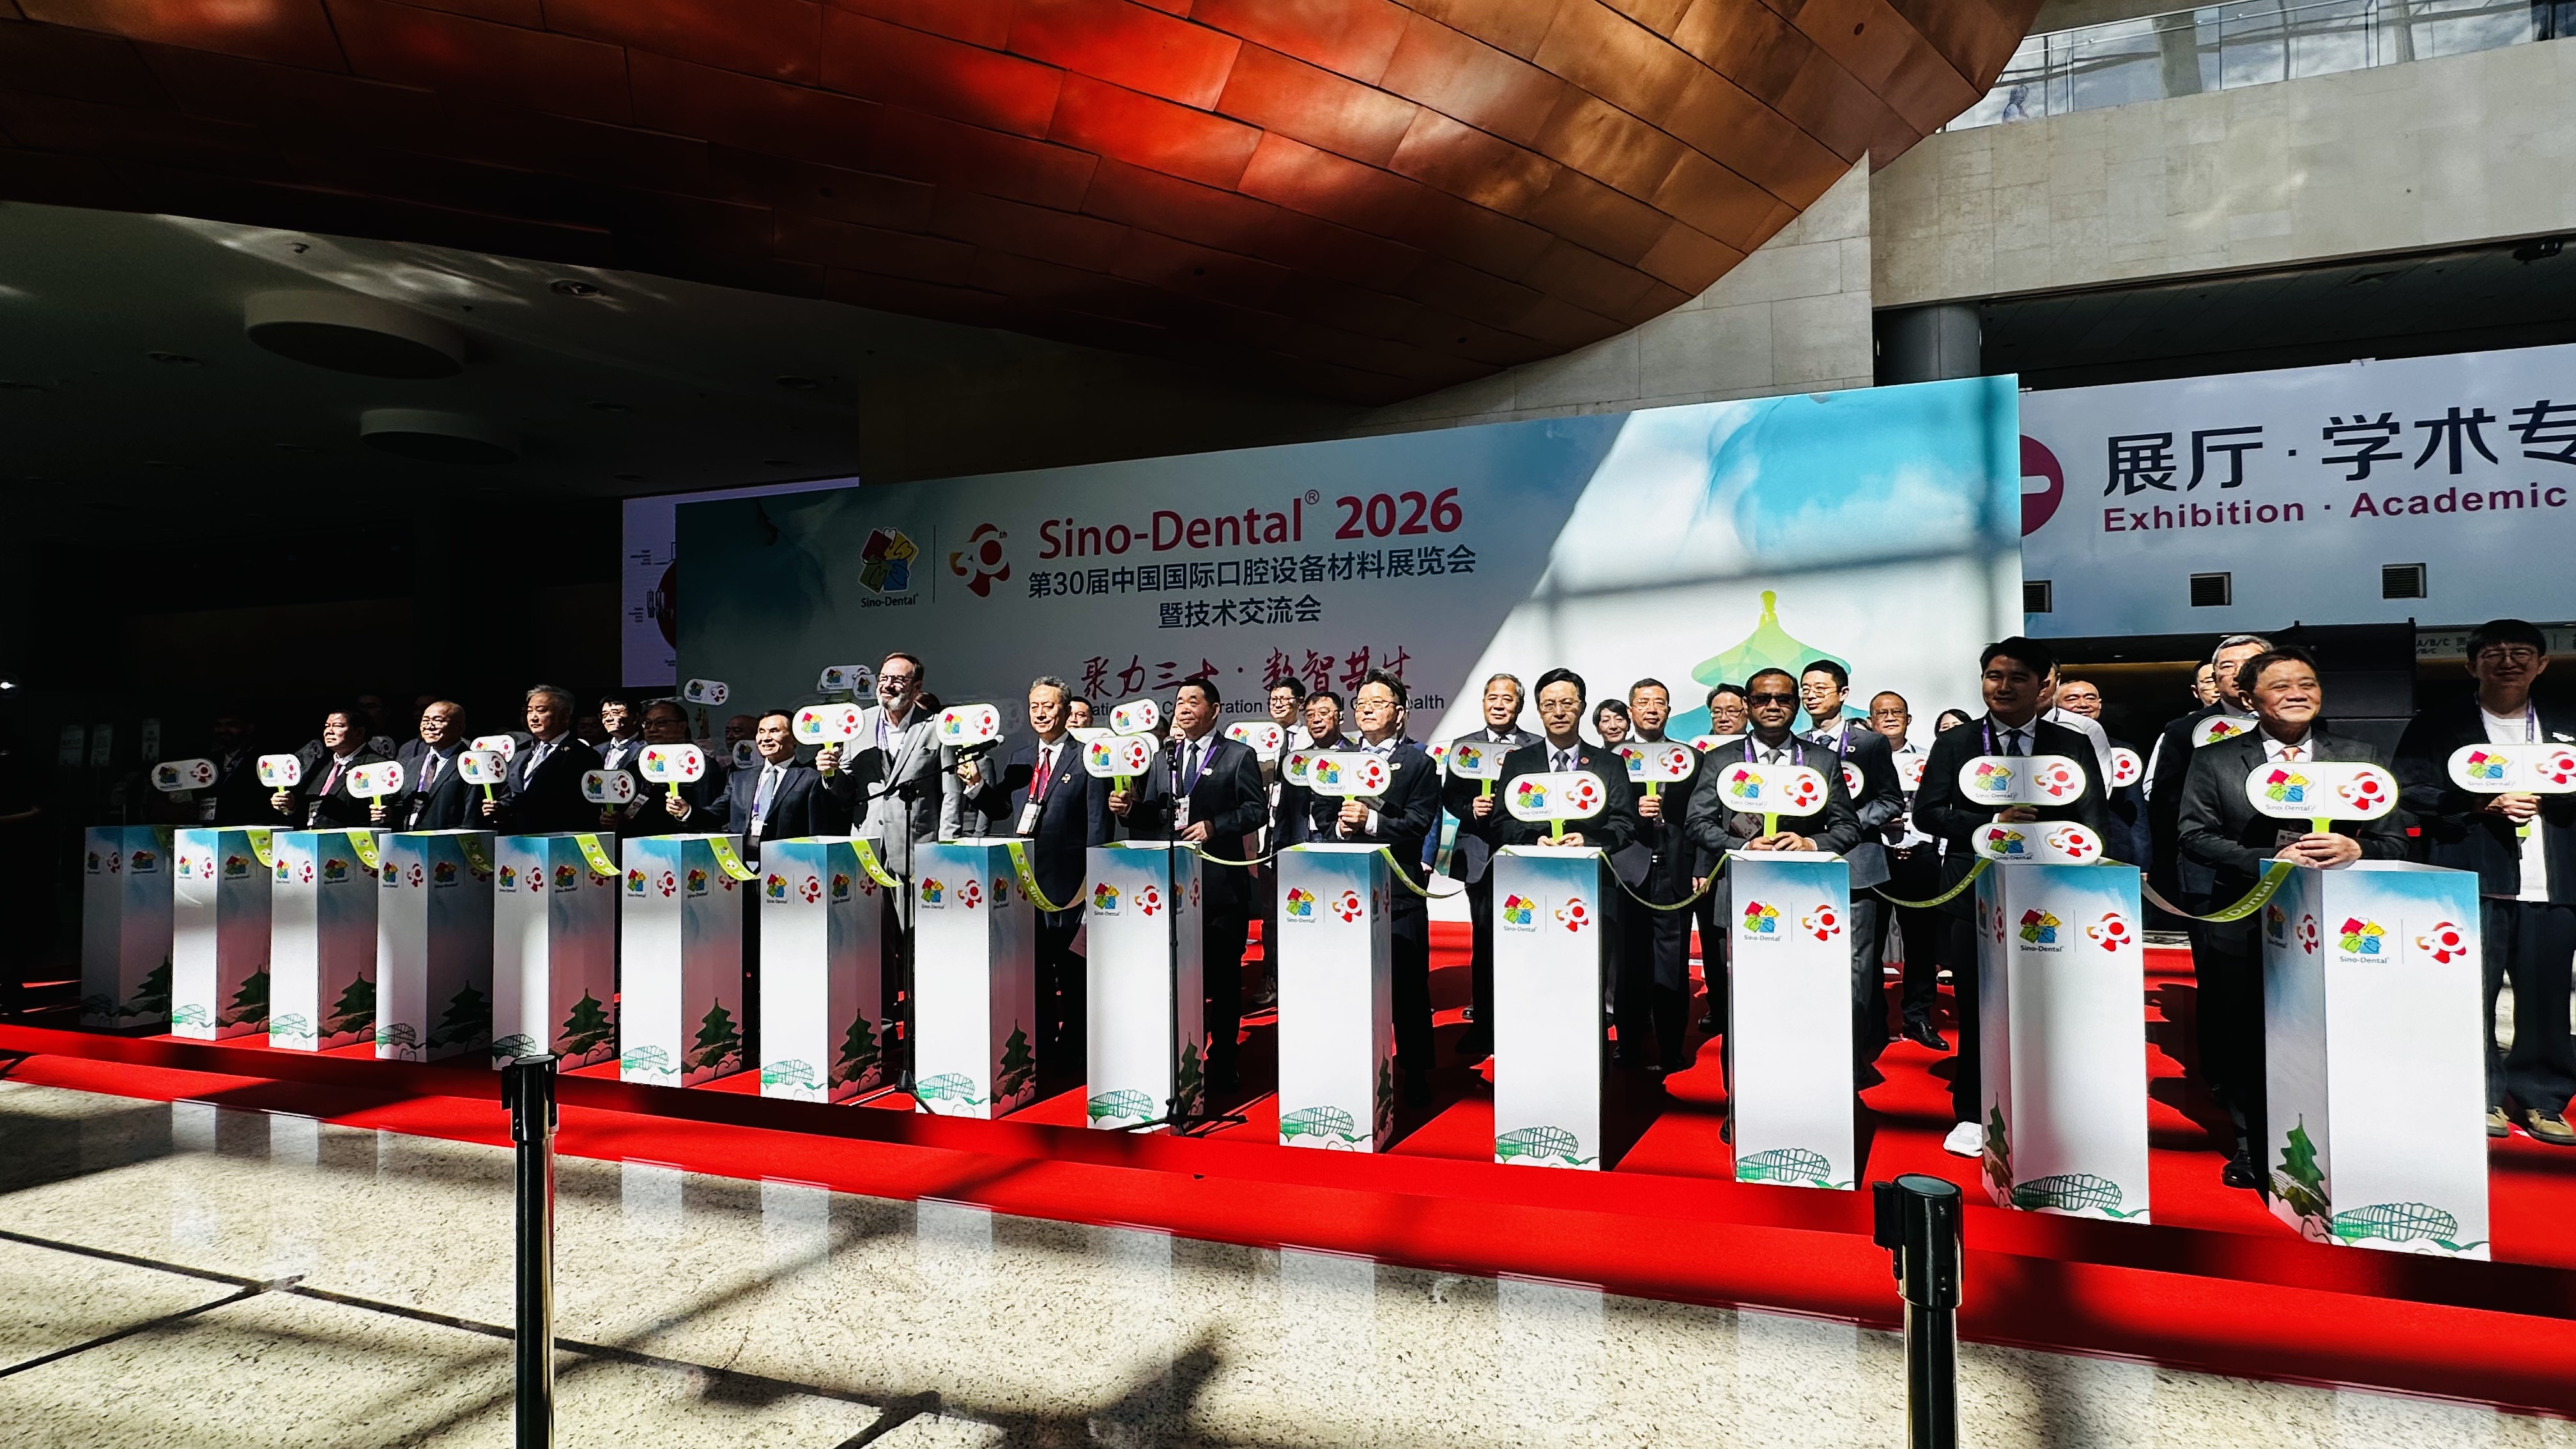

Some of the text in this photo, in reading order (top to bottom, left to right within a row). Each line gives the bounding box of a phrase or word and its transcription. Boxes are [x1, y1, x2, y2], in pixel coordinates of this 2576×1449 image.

[1335, 487, 1462, 540] 2026
[2103, 482, 2567, 532] Exhibition Academic
[1028, 544, 1476, 599] 第30届中国国际口腔设备材料展览会
[1158, 594, 1322, 629] 暨技术交流会
